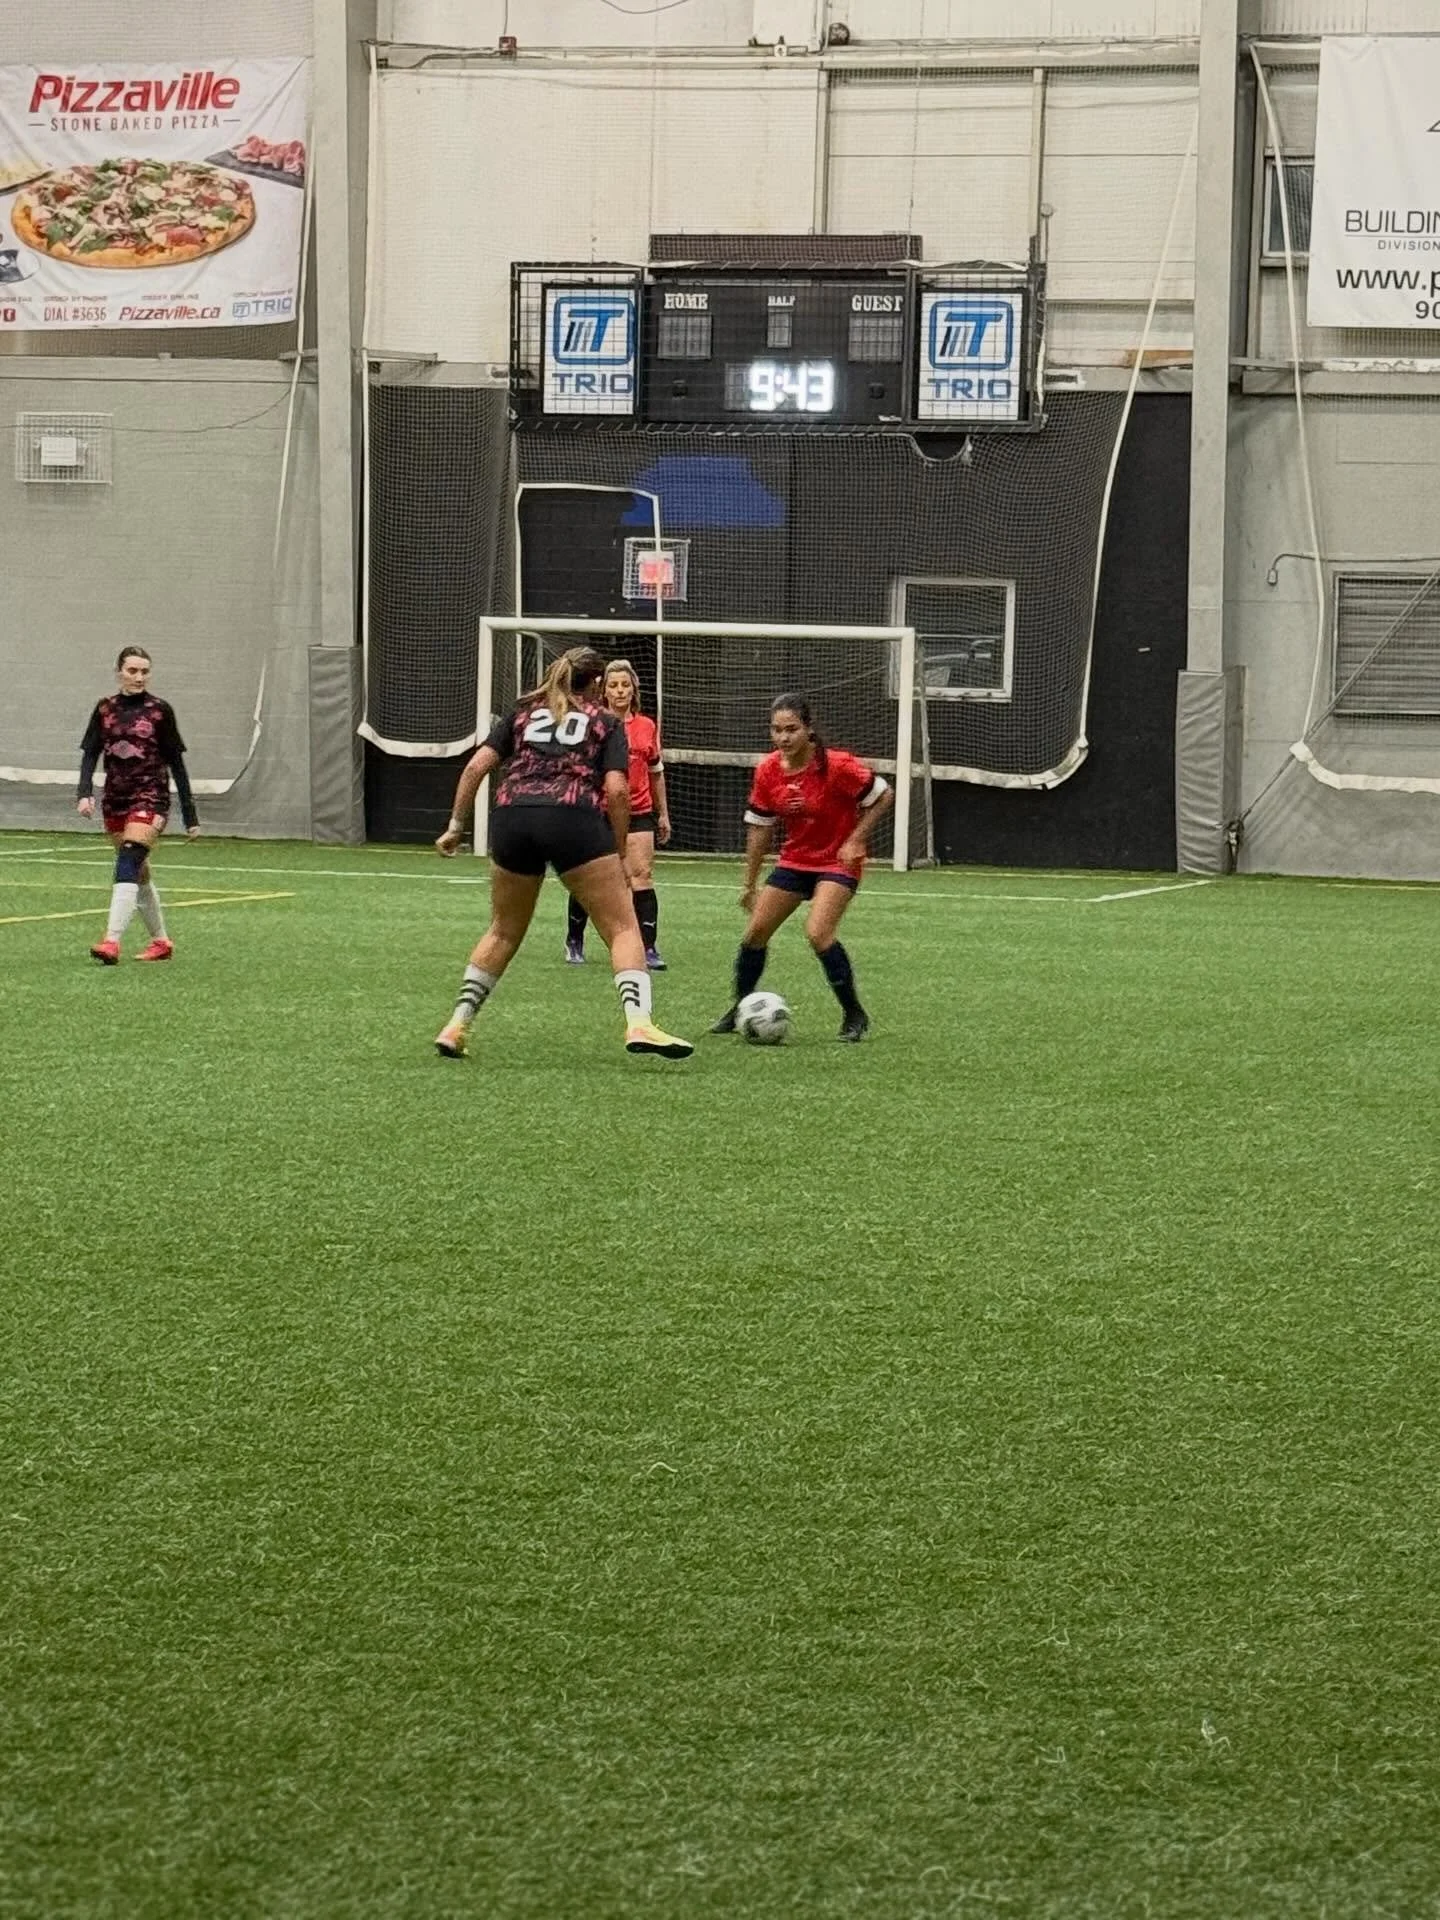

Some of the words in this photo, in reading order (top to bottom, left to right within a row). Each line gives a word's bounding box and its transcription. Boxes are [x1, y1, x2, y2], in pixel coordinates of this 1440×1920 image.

[29, 71, 240, 114] Pizzaville
[50, 117, 101, 132] STONE
[110, 116, 162, 132] BAKED
[171, 114, 220, 129] PIZZA
[1377, 239, 1440, 251] DIVISION
[251, 297, 292, 313] TRIO
[664, 293, 708, 309] HOME
[767, 295, 796, 306] HALF
[852, 294, 904, 311] GUEST
[44, 307, 67, 321] DIAL
[72, 306, 107, 321] #3636
[119, 305, 221, 321] Pizzaville.ca
[552, 373, 634, 394] TRIO
[749, 359, 834, 412] 9:43
[927, 378, 1012, 400] TRIO
[523, 708, 590, 746] 20
